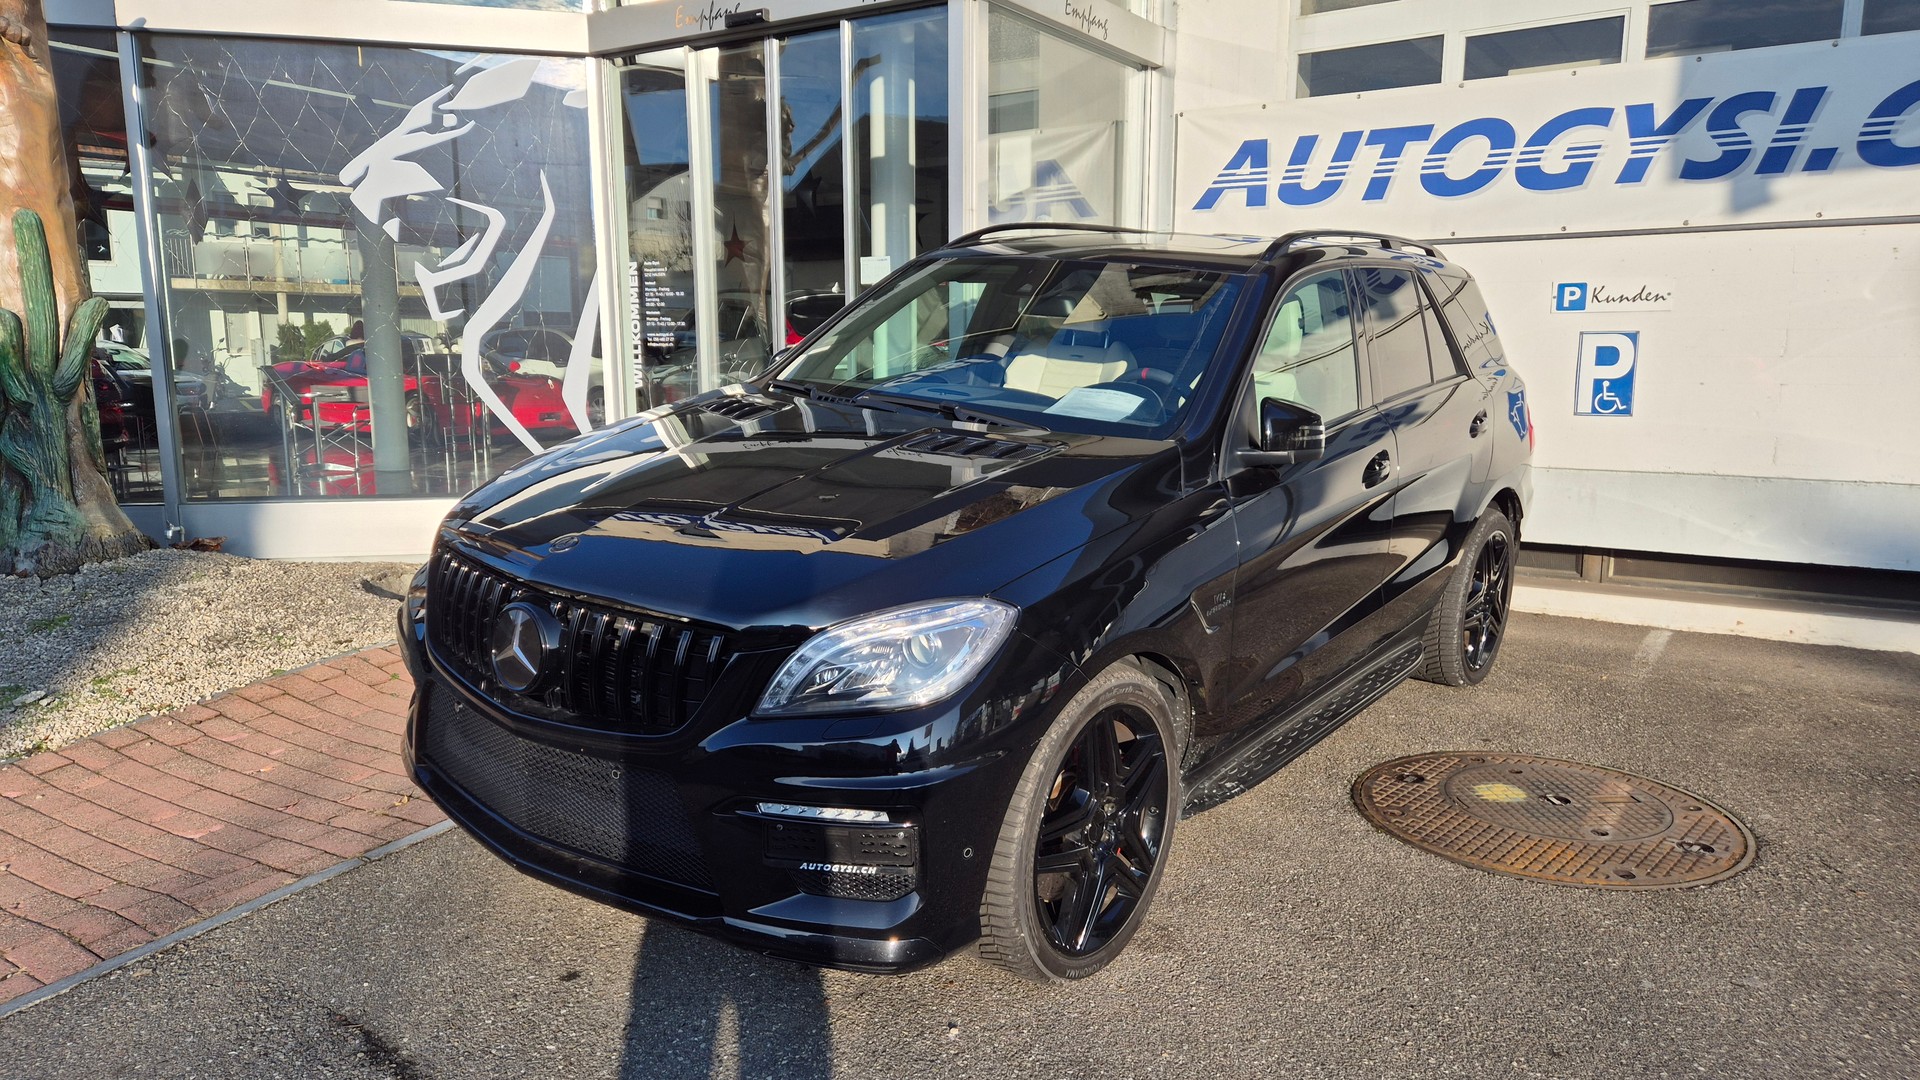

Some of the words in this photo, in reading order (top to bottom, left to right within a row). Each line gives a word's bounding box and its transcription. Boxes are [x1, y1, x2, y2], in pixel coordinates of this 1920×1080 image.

[1065, 0, 1109, 41] Empfang
[1563, 286, 1582, 308] P
[1591, 285, 1667, 304] Kunden
[629, 261, 643, 388] WILLKOMMEN
[1577, 333, 1635, 413] P
[799, 862, 877, 874] AUTOGYSI.CH
